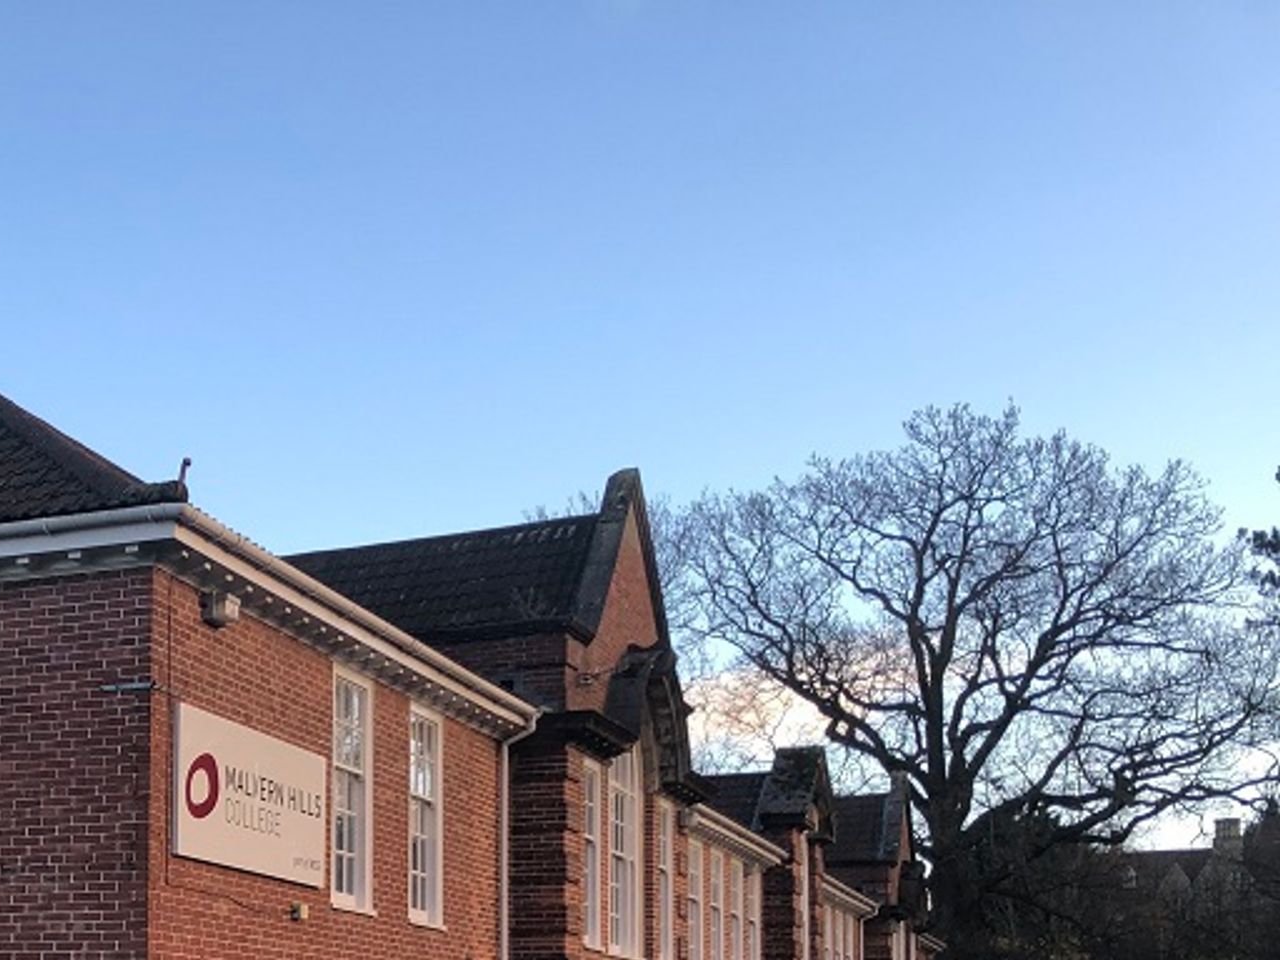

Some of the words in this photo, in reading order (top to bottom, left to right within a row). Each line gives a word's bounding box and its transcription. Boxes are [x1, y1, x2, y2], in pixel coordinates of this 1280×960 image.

[225, 765, 284, 807] MALVERN
[287, 786, 321, 819] HILLS
[224, 797, 282, 839] COLLEGE
